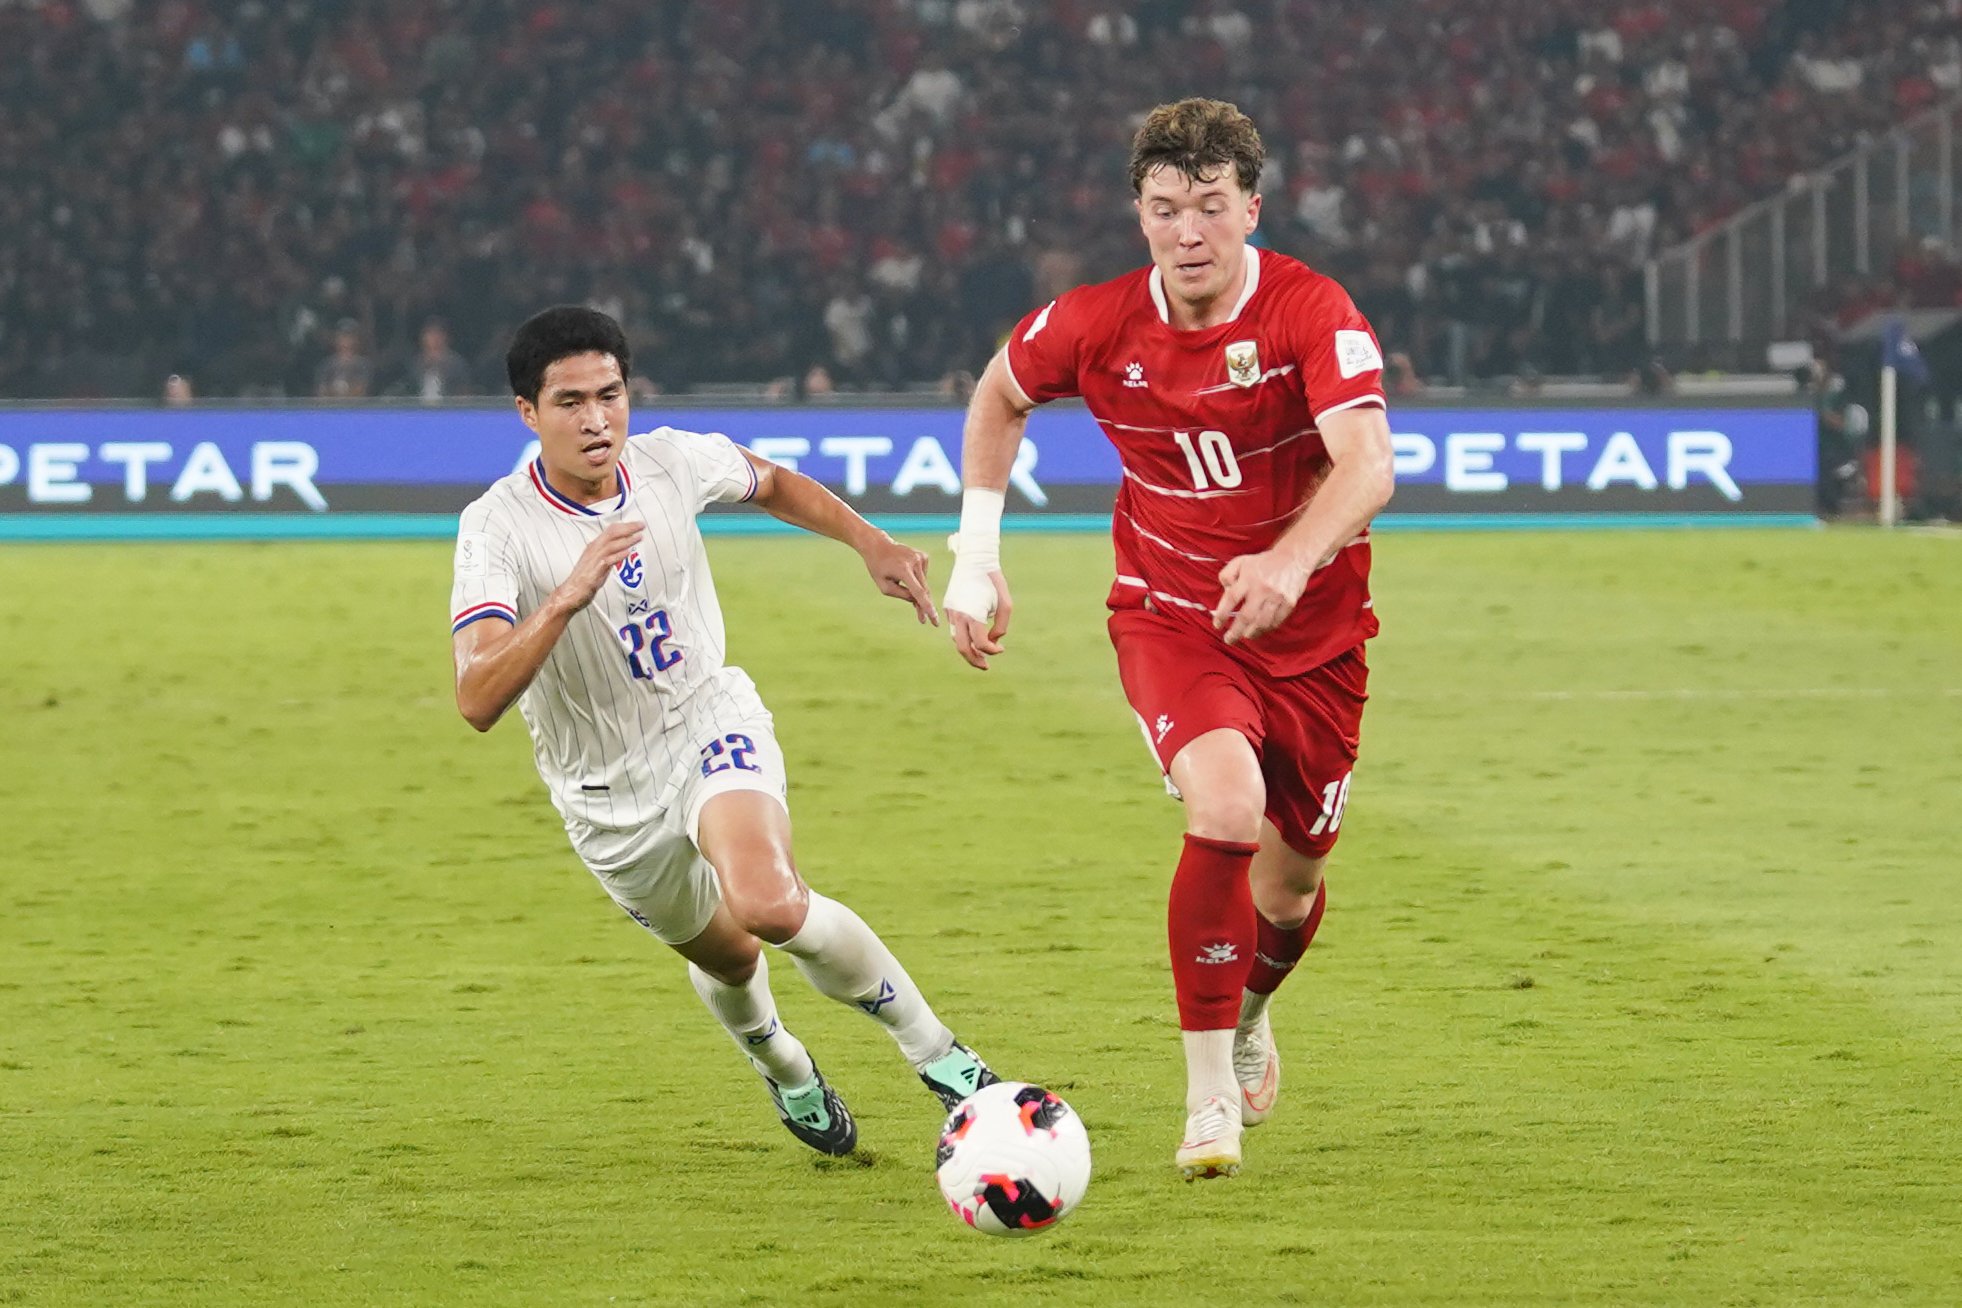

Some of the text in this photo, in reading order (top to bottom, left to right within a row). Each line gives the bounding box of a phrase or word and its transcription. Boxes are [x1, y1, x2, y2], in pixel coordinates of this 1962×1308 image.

[1174, 430, 1243, 490] 10
[618, 609, 684, 681] 22
[700, 732, 762, 779] 22
[1308, 770, 1352, 836] 10
